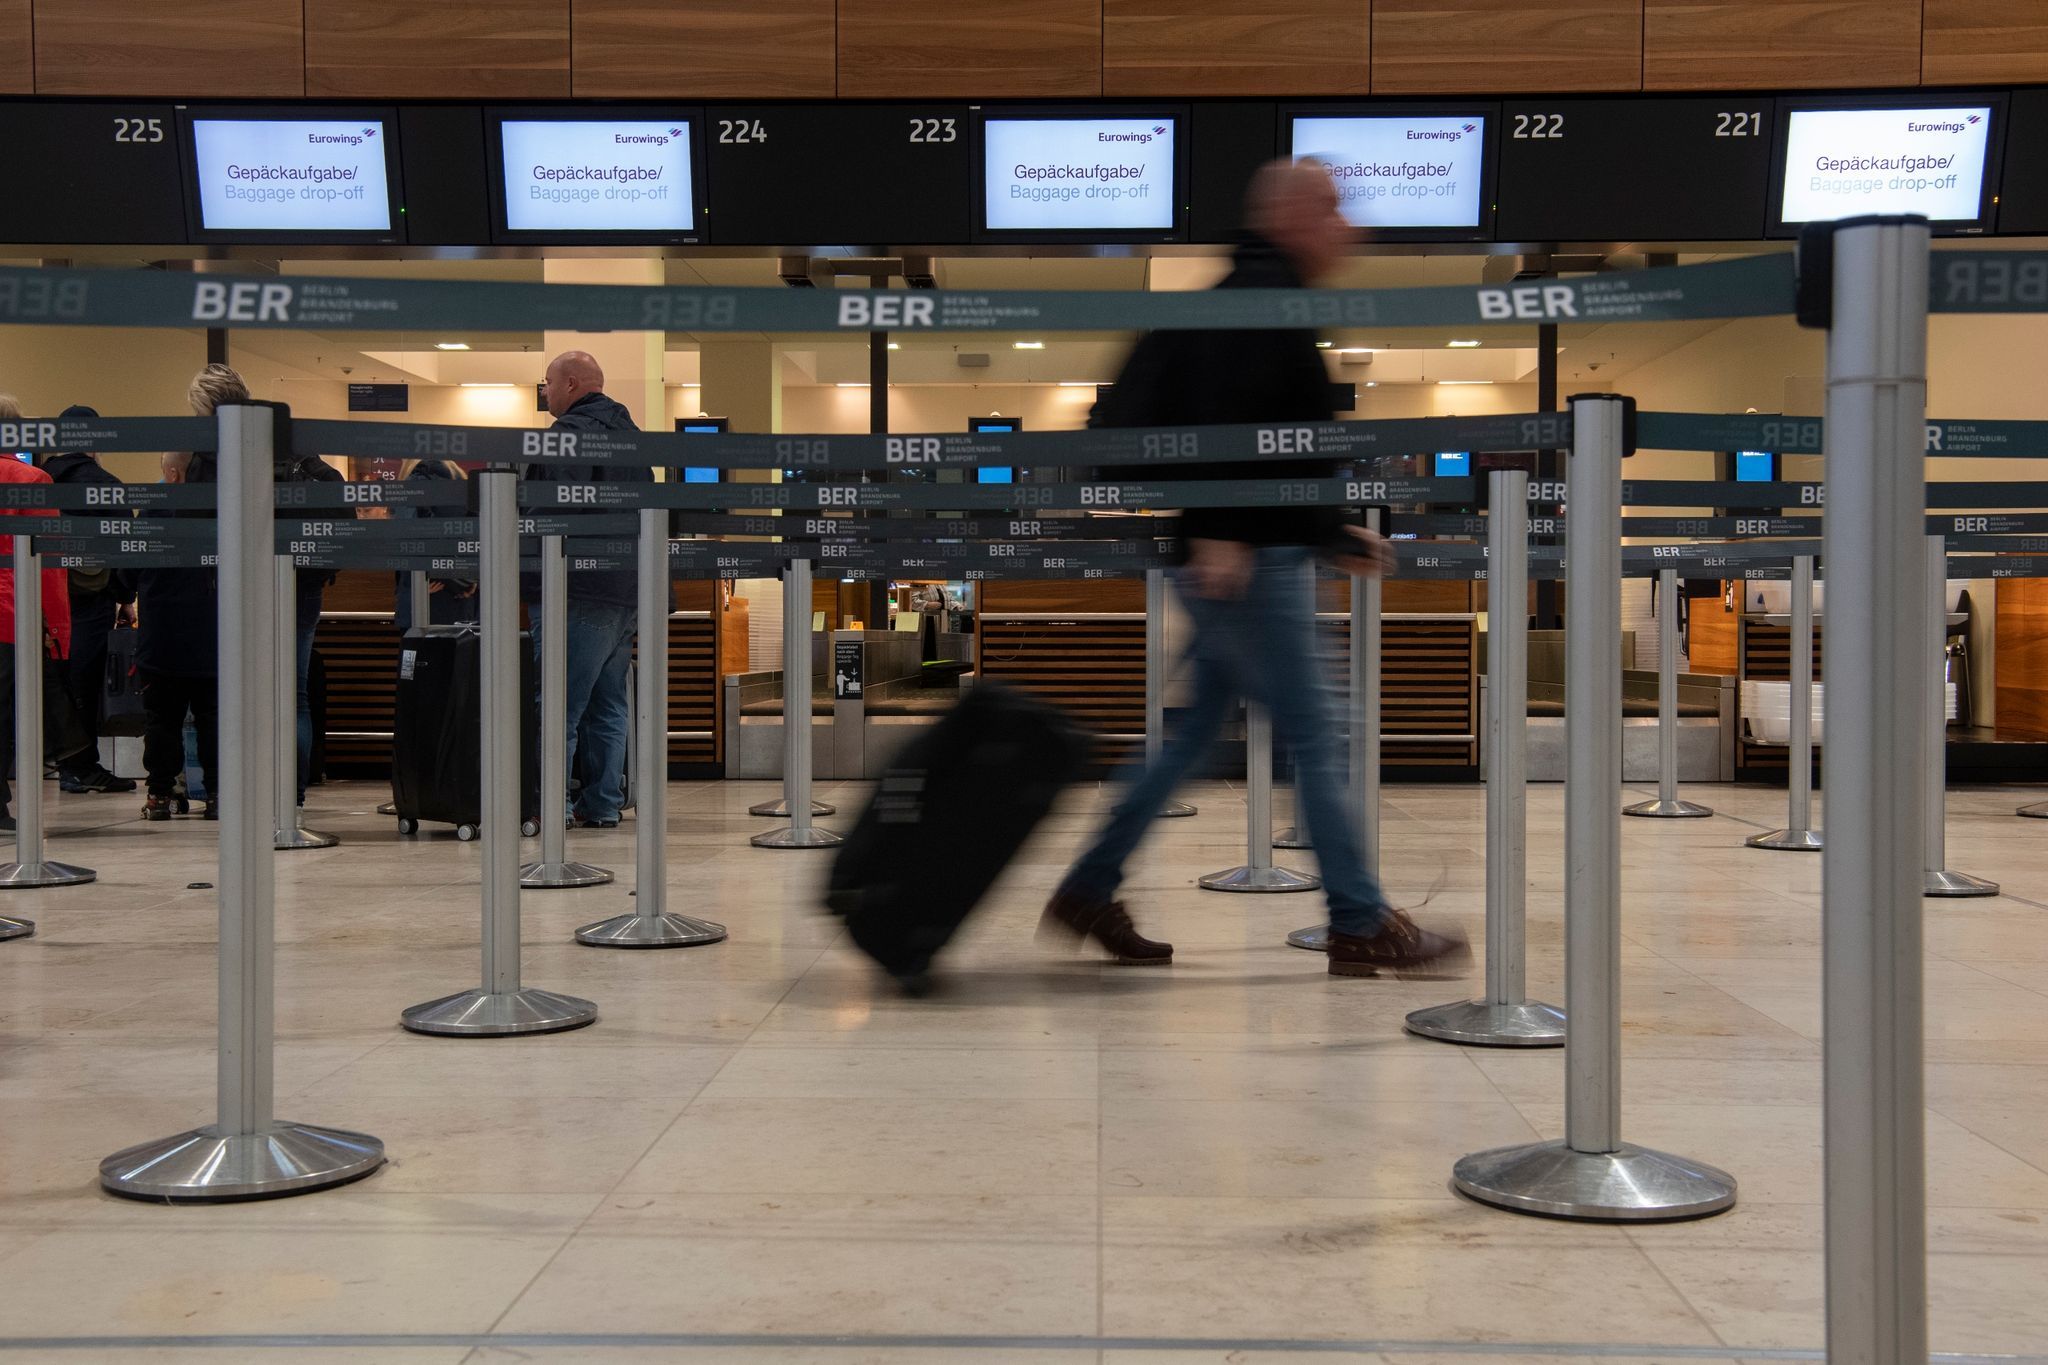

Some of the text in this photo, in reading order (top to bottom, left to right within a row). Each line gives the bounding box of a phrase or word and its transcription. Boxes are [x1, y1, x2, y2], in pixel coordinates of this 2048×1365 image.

[1513, 115, 1564, 138] 222
[1715, 112, 1761, 136] 221
[1908, 121, 1965, 134] Eurowings
[114, 119, 163, 142] 225
[719, 120, 767, 143] 224
[909, 119, 957, 142] 223
[1406, 130, 1461, 141] Eurowings
[309, 134, 363, 146] Eurowings
[615, 134, 669, 146] Eurowings
[1098, 132, 1152, 144] Eurowings
[1816, 154, 1955, 173] Gepäckaufgabe/
[227, 165, 358, 183] Gepäckaufgabe/
[533, 166, 663, 183] Gepäckaufgabe/
[1014, 164, 1145, 182] Gepäckaufgabe/
[1810, 174, 1957, 194] Baggage drop-off
[225, 185, 364, 202] Baggage drop-off
[530, 186, 668, 203] Baggage drop-off
[1010, 184, 1149, 201] Baggage drop-off
[1337, 182, 1456, 200] ggage drop-off
[302, 285, 348, 296] BERLIN
[1582, 281, 1629, 293] BERLIN
[191, 281, 293, 322] BER
[301, 299, 398, 312] BRANDENBURG
[943, 297, 989, 306] BERLIN
[1477, 285, 1577, 320] BER
[838, 295, 935, 327] BER
[942, 307, 1040, 317] BRANDENBURG
[1585, 304, 1642, 318] AIRPORT
[299, 312, 354, 323] AIRPORT
[941, 317, 998, 327] AIRPORT
[61, 422, 88, 430] BERLIN
[1318, 426, 1346, 434] BERLIN
[1947, 425, 1976, 433] BERLIN
[1, 423, 56, 448] BER
[61, 431, 117, 439] BRANDENBURG
[582, 433, 608, 441] BERLIN
[1257, 428, 1314, 454] BER
[1318, 435, 1377, 443] BRANDENBURG
[1947, 434, 2008, 442] BRANDENBURG
[61, 440, 93, 448] AIRPORT
[523, 432, 577, 457] BER
[581, 442, 637, 450] BRANDENBURG
[1318, 444, 1352, 452] AIRPORT
[581, 451, 612, 459] AIRPORT
[886, 438, 941, 463] BER
[945, 455, 978, 463] AIRPORT
[86, 487, 125, 505] BER
[344, 485, 382, 502] BER
[558, 485, 597, 503] BER
[818, 487, 857, 505] BER
[1081, 487, 1120, 504] BER
[1346, 482, 1386, 500] BER
[1527, 482, 1566, 500] BER
[1801, 486, 1824, 504] BE
[101, 520, 130, 534] BER
[302, 522, 332, 536] BER
[518, 519, 535, 533] ER
[806, 520, 836, 534] BER
[1010, 521, 1041, 535] BER
[1736, 520, 1768, 534] BER
[1954, 517, 1987, 532] BER
[121, 541, 147, 552] BER
[290, 541, 316, 553] BER
[822, 545, 847, 557] BER
[989, 545, 1015, 556] BER
[1158, 541, 1175, 553] BE
[1653, 547, 1680, 557] BER
[61, 557, 83, 567] BER
[295, 555, 310, 566] ER
[432, 559, 454, 569] BER
[575, 560, 597, 569] BER
[717, 557, 739, 567] BER
[1043, 558, 1065, 568] BER
[1417, 557, 1439, 567] BER
[1703, 557, 1726, 566] BER
[721, 569, 739, 579] BER
[847, 569, 866, 578] BER
[966, 570, 984, 579] BER
[1084, 569, 1102, 578] BER
[1475, 570, 1488, 579] BE
[1745, 569, 1764, 578] BER
